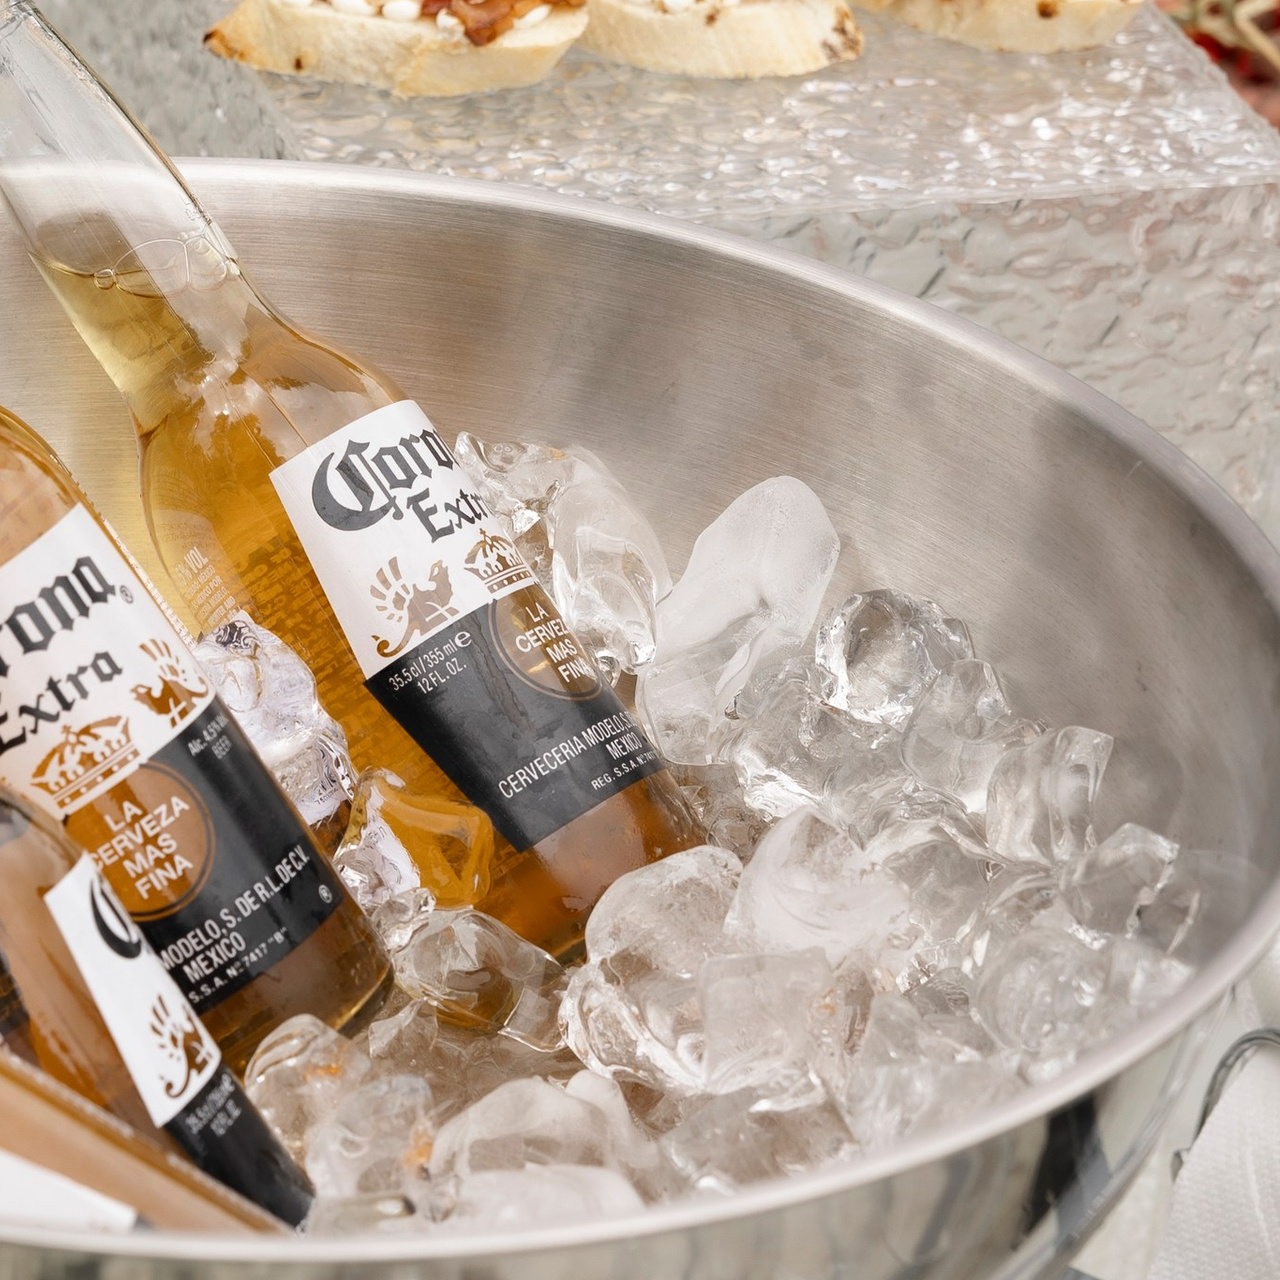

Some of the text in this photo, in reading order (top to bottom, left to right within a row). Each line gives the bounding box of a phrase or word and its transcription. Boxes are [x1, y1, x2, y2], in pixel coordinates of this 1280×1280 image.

[311, 428, 461, 532] Coro
[406, 487, 493, 544] Extr
[525, 601, 549, 623] LA
[515, 618, 570, 653] CERVEZ
[546, 638, 578, 664] MAS
[450, 657, 468, 678] OZ.
[557, 656, 592, 683] FINA
[605, 731, 644, 761] MEXICO
[498, 735, 588, 799] CERVECERIA
[590, 772, 616, 791] REG.
[103, 800, 143, 833] LA
[122, 832, 178, 879] MAS
[134, 854, 194, 901] FINA
[160, 918, 228, 970] MODELO,
[234, 889, 261, 918] DE
[182, 930, 247, 984] MEXICO
[241, 943, 269, 968] 7417
